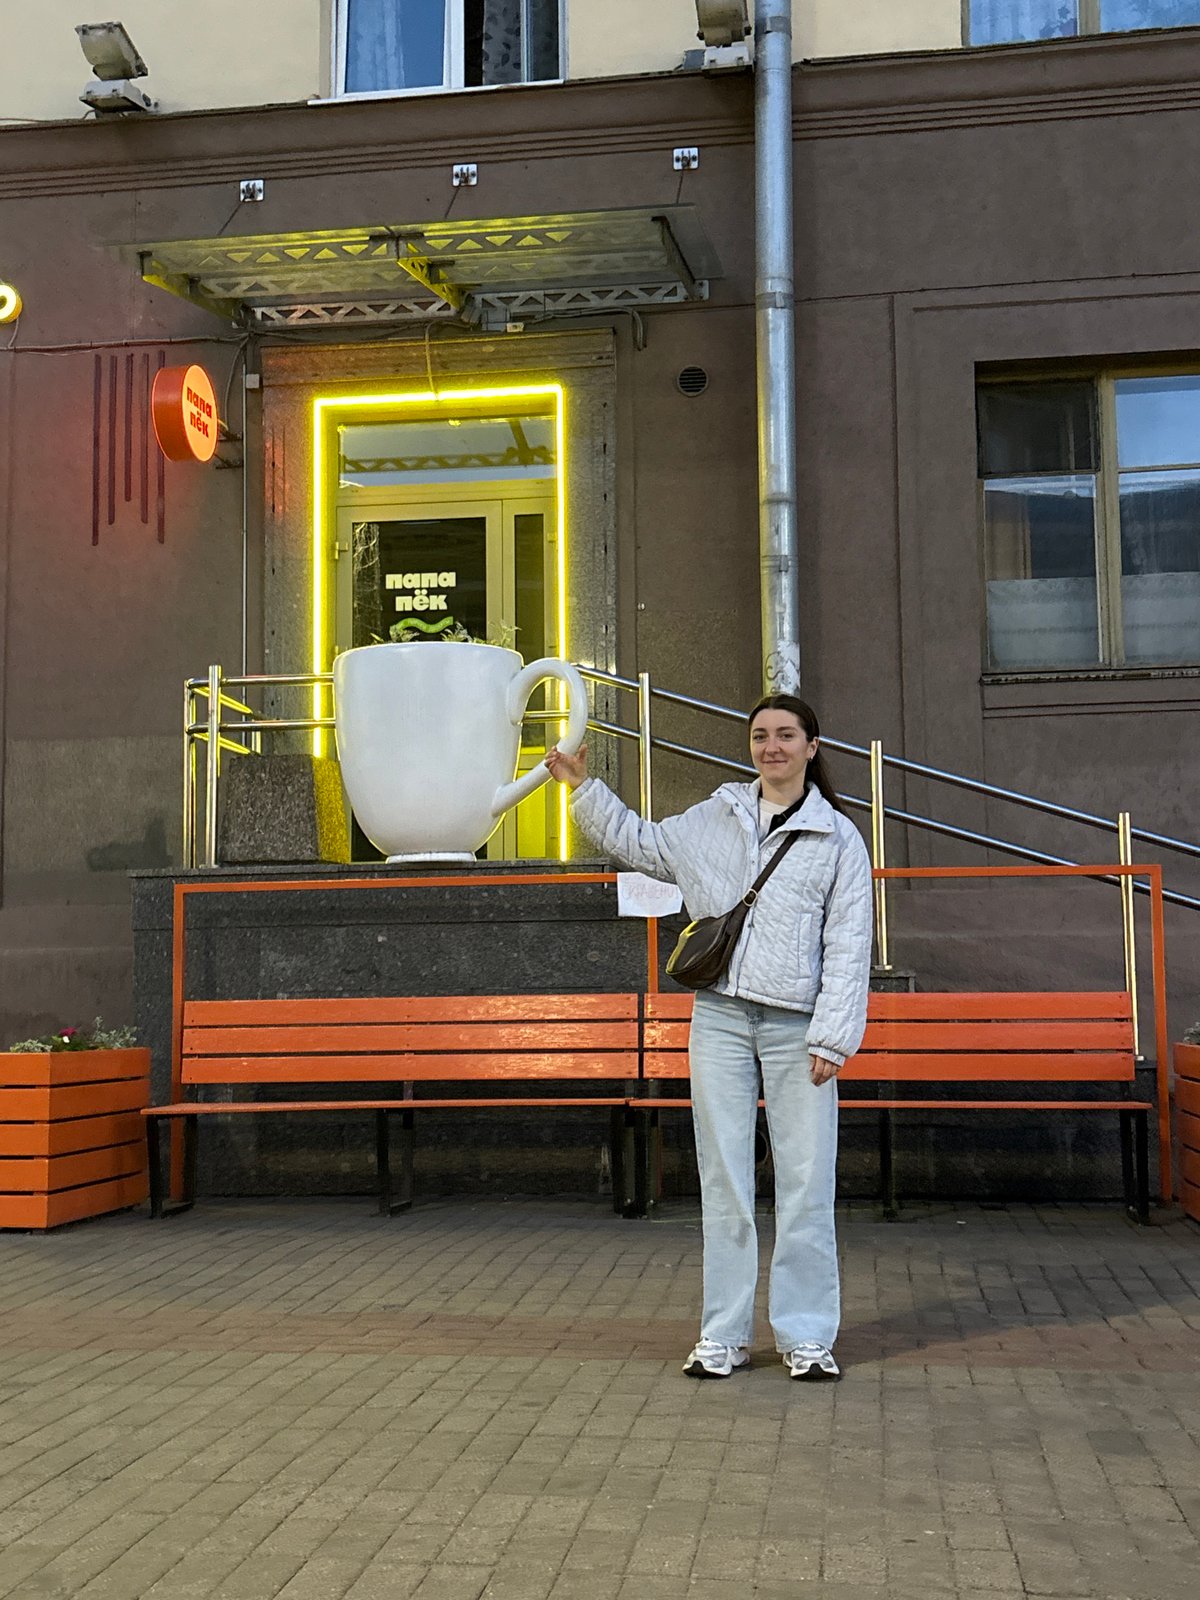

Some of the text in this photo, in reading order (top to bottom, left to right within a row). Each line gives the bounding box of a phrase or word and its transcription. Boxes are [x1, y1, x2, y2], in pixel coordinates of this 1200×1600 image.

[187, 387, 212, 418] папа
[190, 411, 209, 438] пёк
[385, 572, 456, 589] папа
[395, 589, 448, 611] пёк
